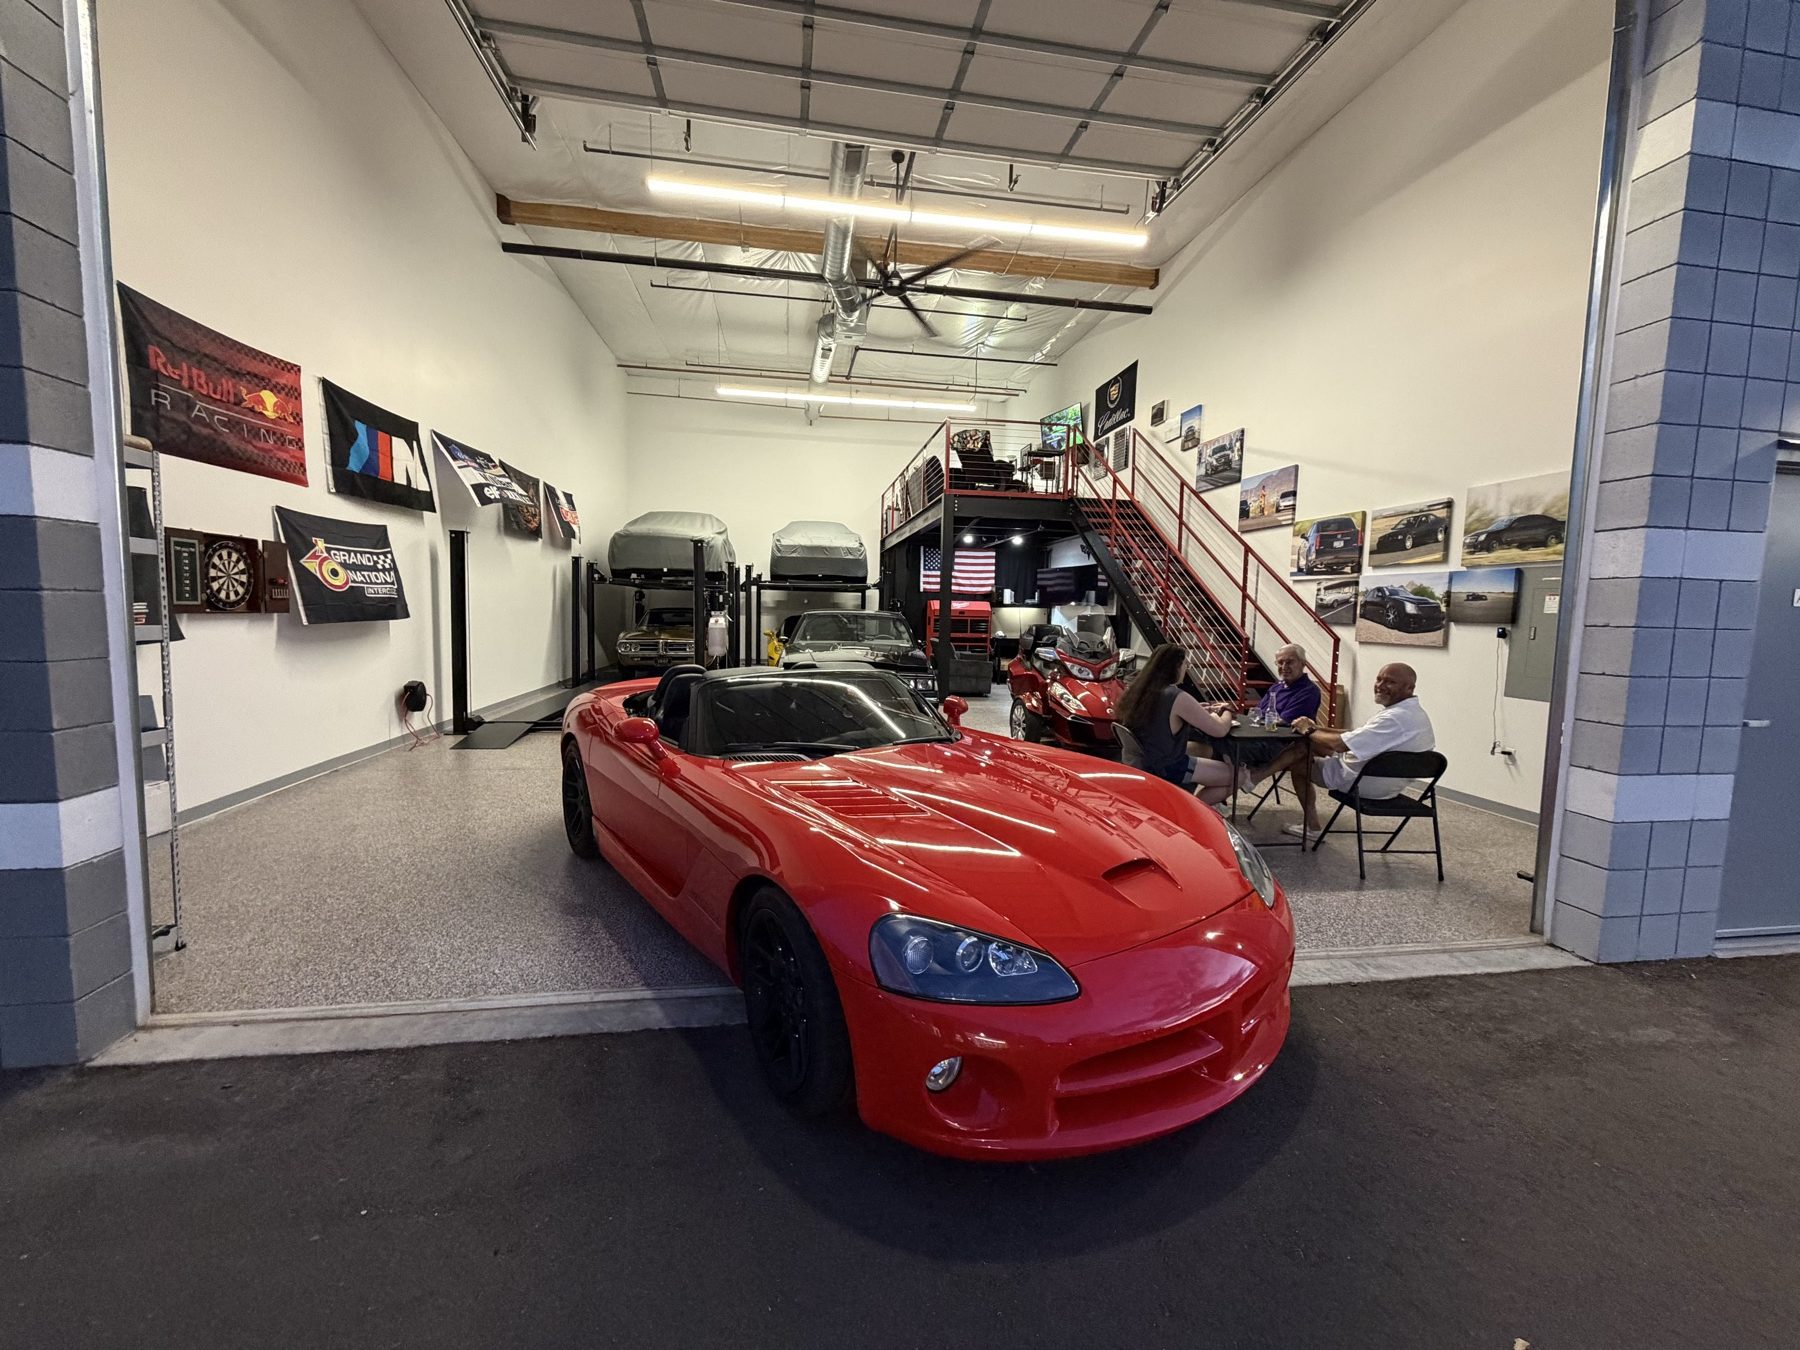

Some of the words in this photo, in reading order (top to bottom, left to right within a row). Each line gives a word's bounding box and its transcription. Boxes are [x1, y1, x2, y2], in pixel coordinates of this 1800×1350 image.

[148, 344, 189, 387] Red
[191, 367, 235, 403] Bull
[151, 389, 298, 449] RACING
[1097, 408, 1130, 436] Cadillac
[483, 485, 501, 499] elf
[330, 550, 374, 566] GRAND
